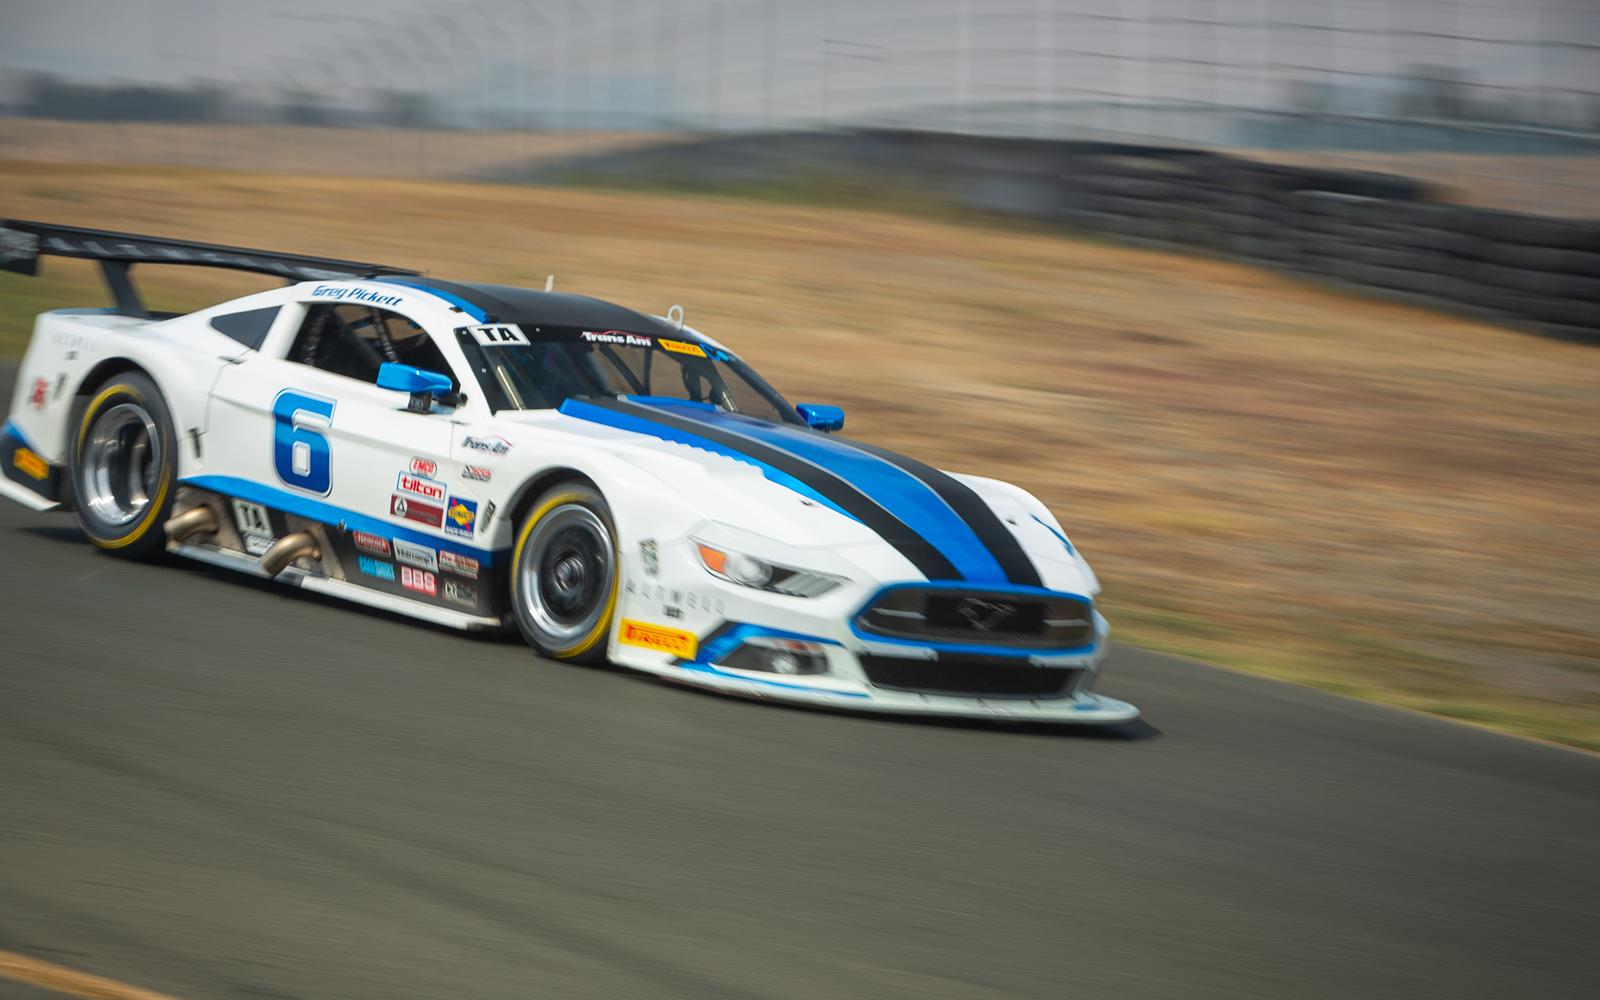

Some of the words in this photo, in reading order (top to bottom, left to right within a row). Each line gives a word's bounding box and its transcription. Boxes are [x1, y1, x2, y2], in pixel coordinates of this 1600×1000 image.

[312, 285, 349, 299] Greg
[348, 287, 403, 306] Pickett
[477, 327, 521, 342] TA
[581, 330, 625, 344] Trans
[626, 334, 652, 347] Am
[271, 387, 337, 499] 6
[401, 475, 443, 500] tilton
[401, 564, 437, 594] BBS
